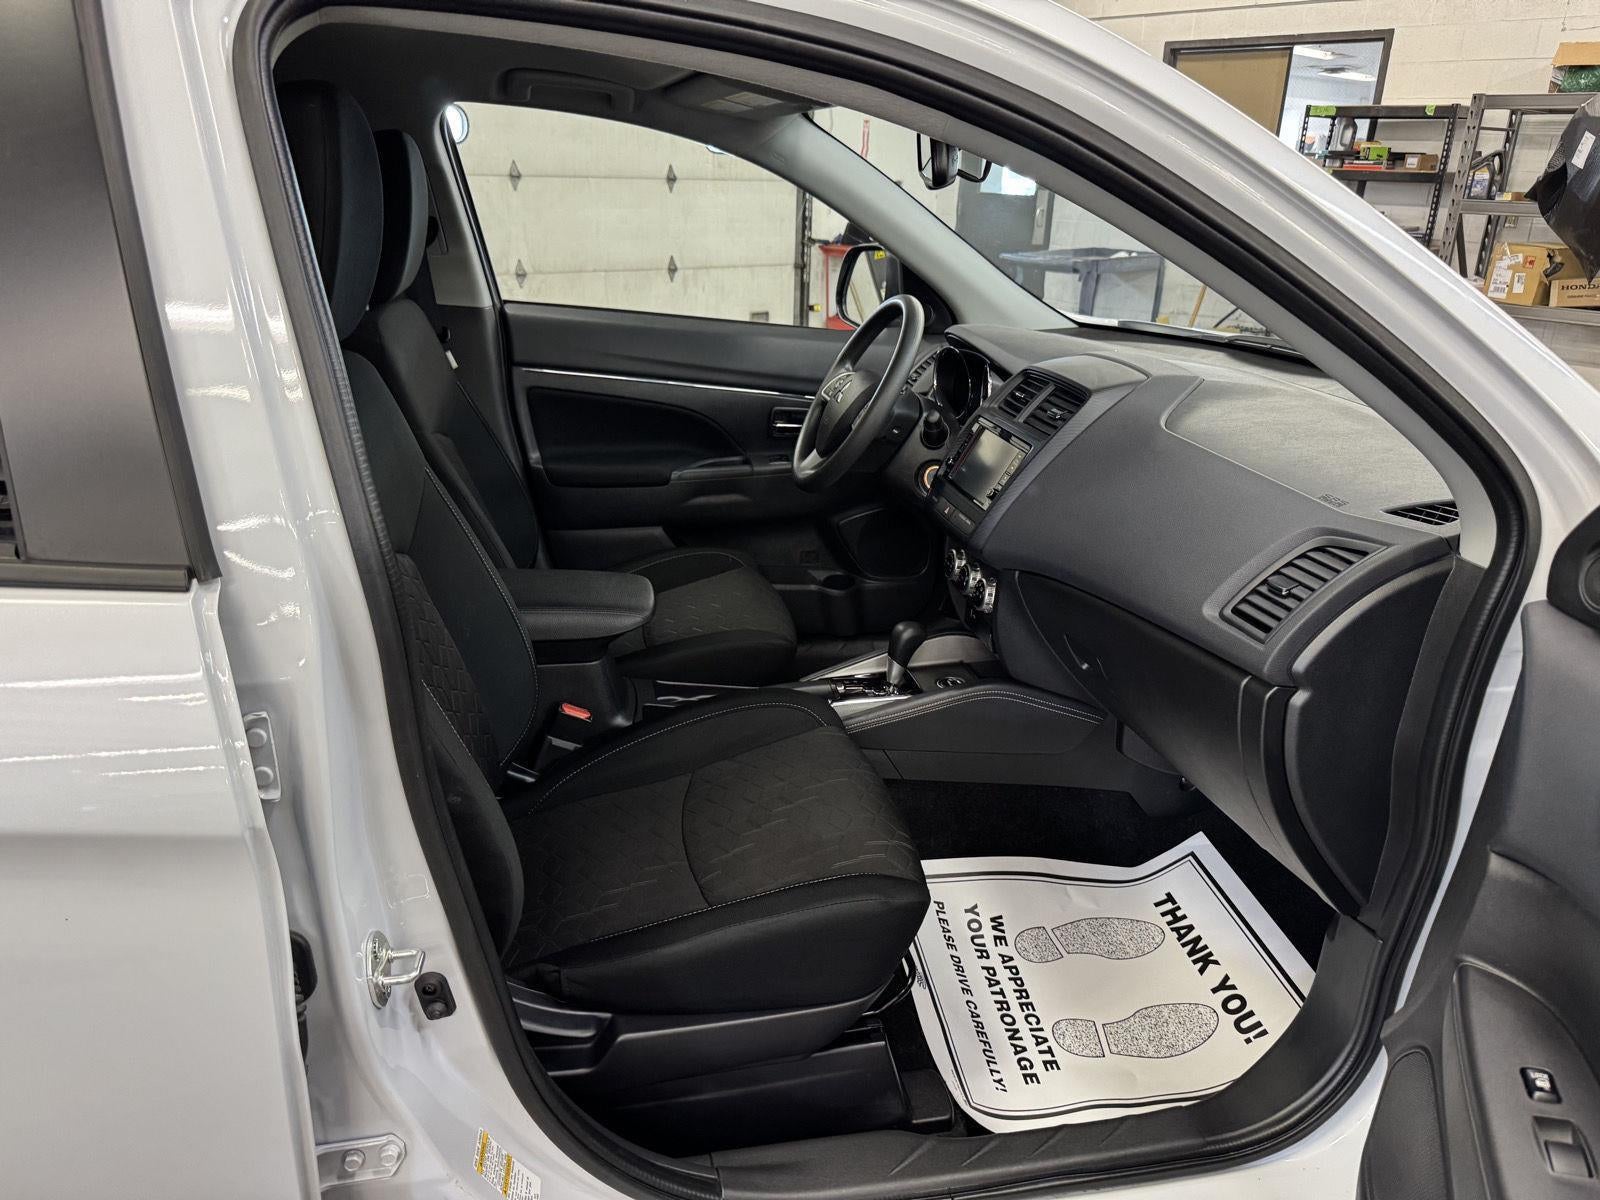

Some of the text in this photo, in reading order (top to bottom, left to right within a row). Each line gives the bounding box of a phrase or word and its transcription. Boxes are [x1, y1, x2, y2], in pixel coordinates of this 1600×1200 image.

[933, 900, 1008, 1093] PLEASE DRIVE CAREFULLY!
[964, 903, 1041, 1085] YOUR PATRONAGE
[990, 915, 1061, 1072] WE APPRECIATE
[1153, 891, 1269, 1045] THANK YOU!
